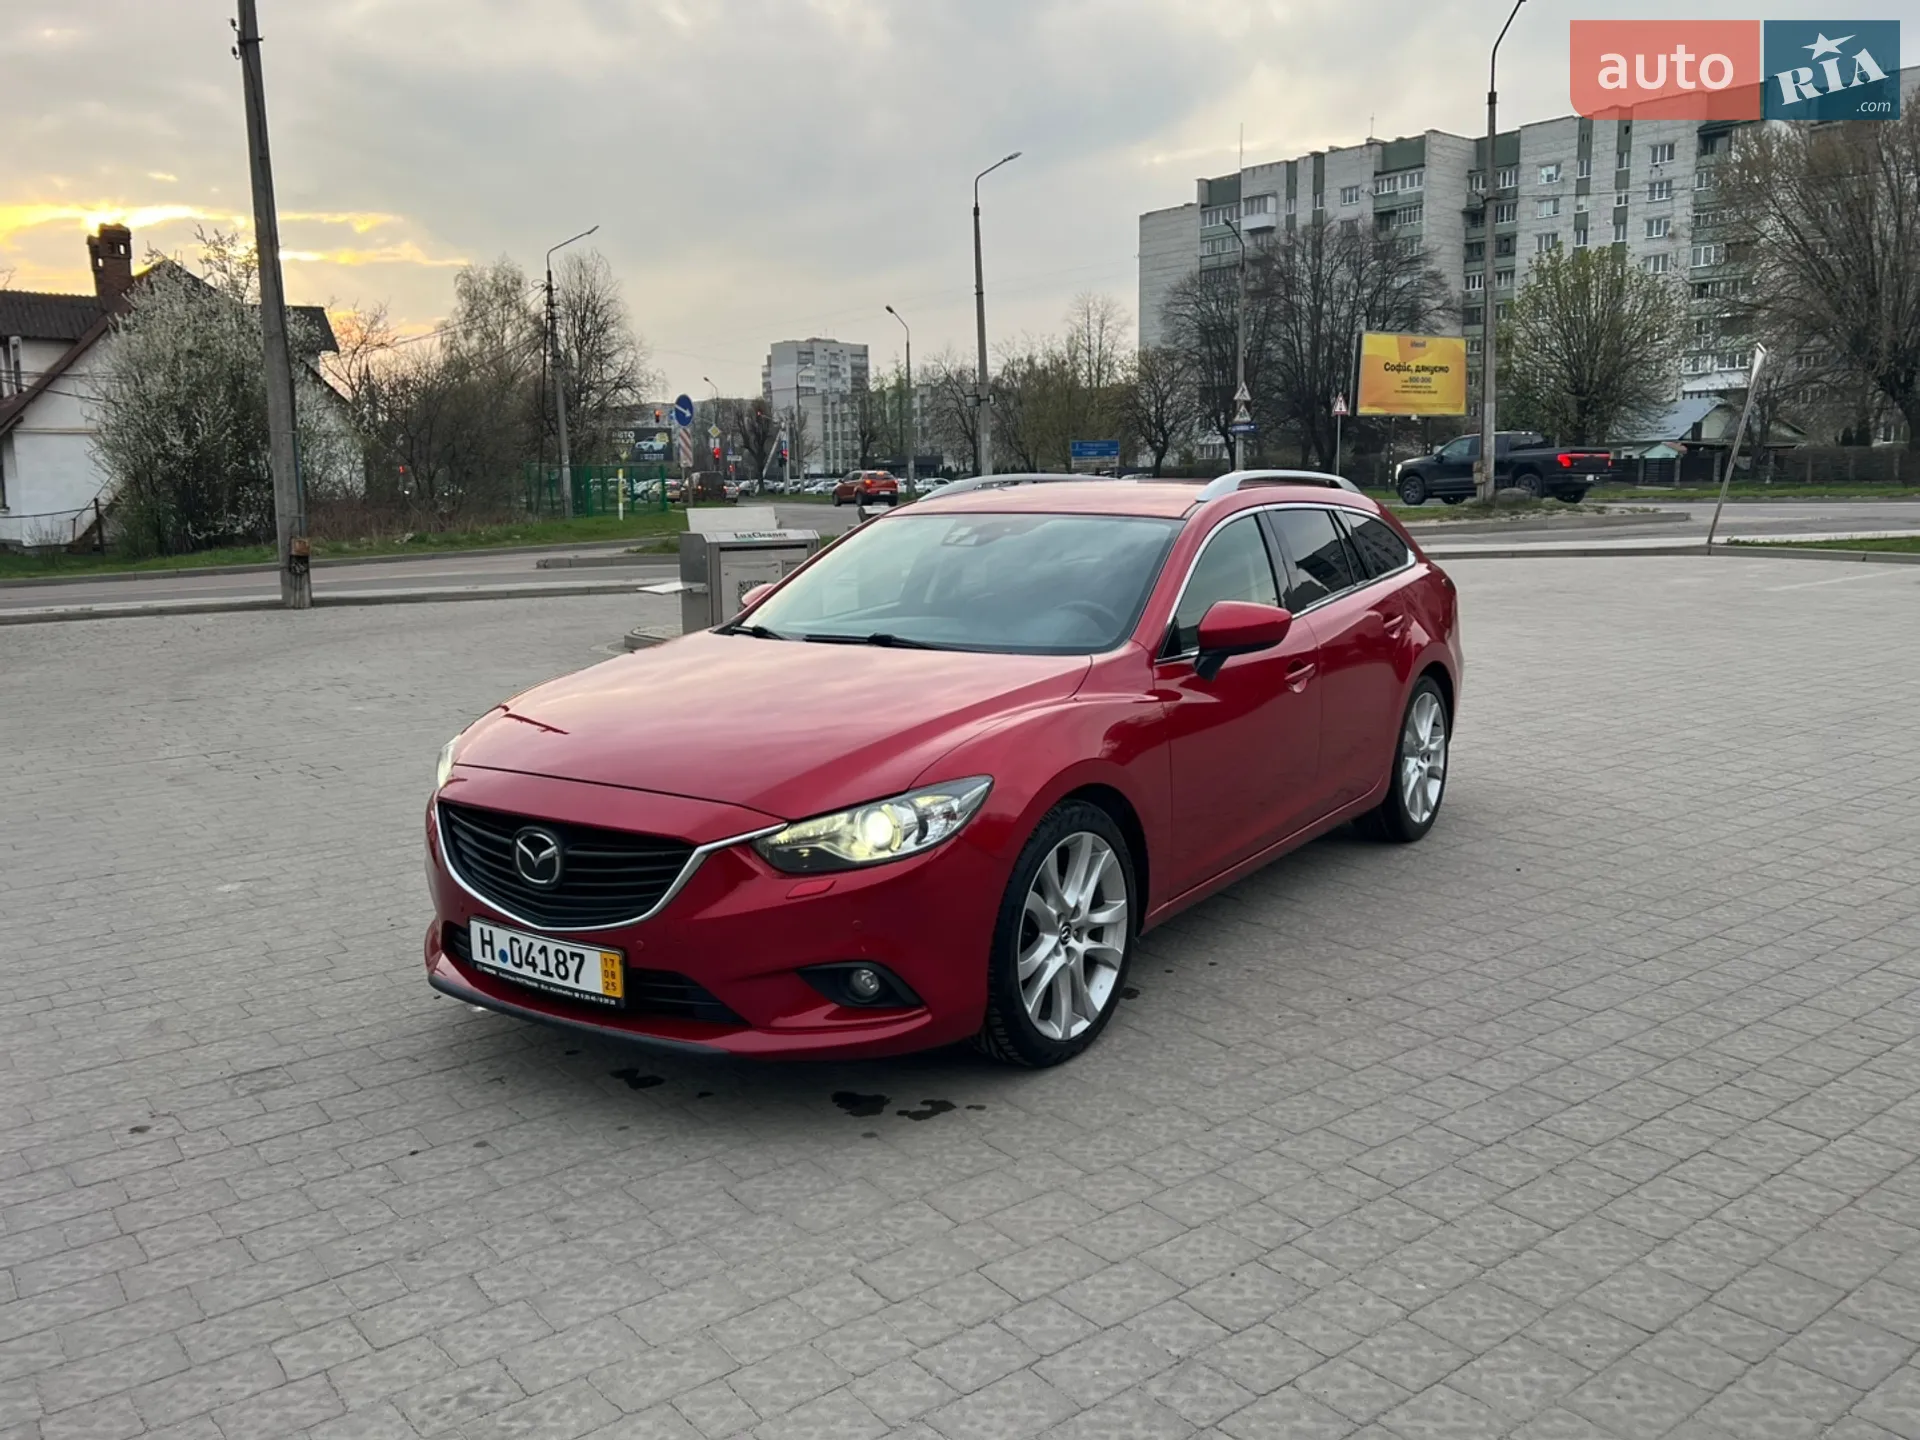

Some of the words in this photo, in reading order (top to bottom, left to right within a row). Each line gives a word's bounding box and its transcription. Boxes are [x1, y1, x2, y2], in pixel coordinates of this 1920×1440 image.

[733, 531, 788, 540] LuxCleaner
[479, 927, 496, 961] H
[508, 936, 586, 984] 04187
[603, 957, 615, 969] 17
[604, 980, 617, 992] 25
